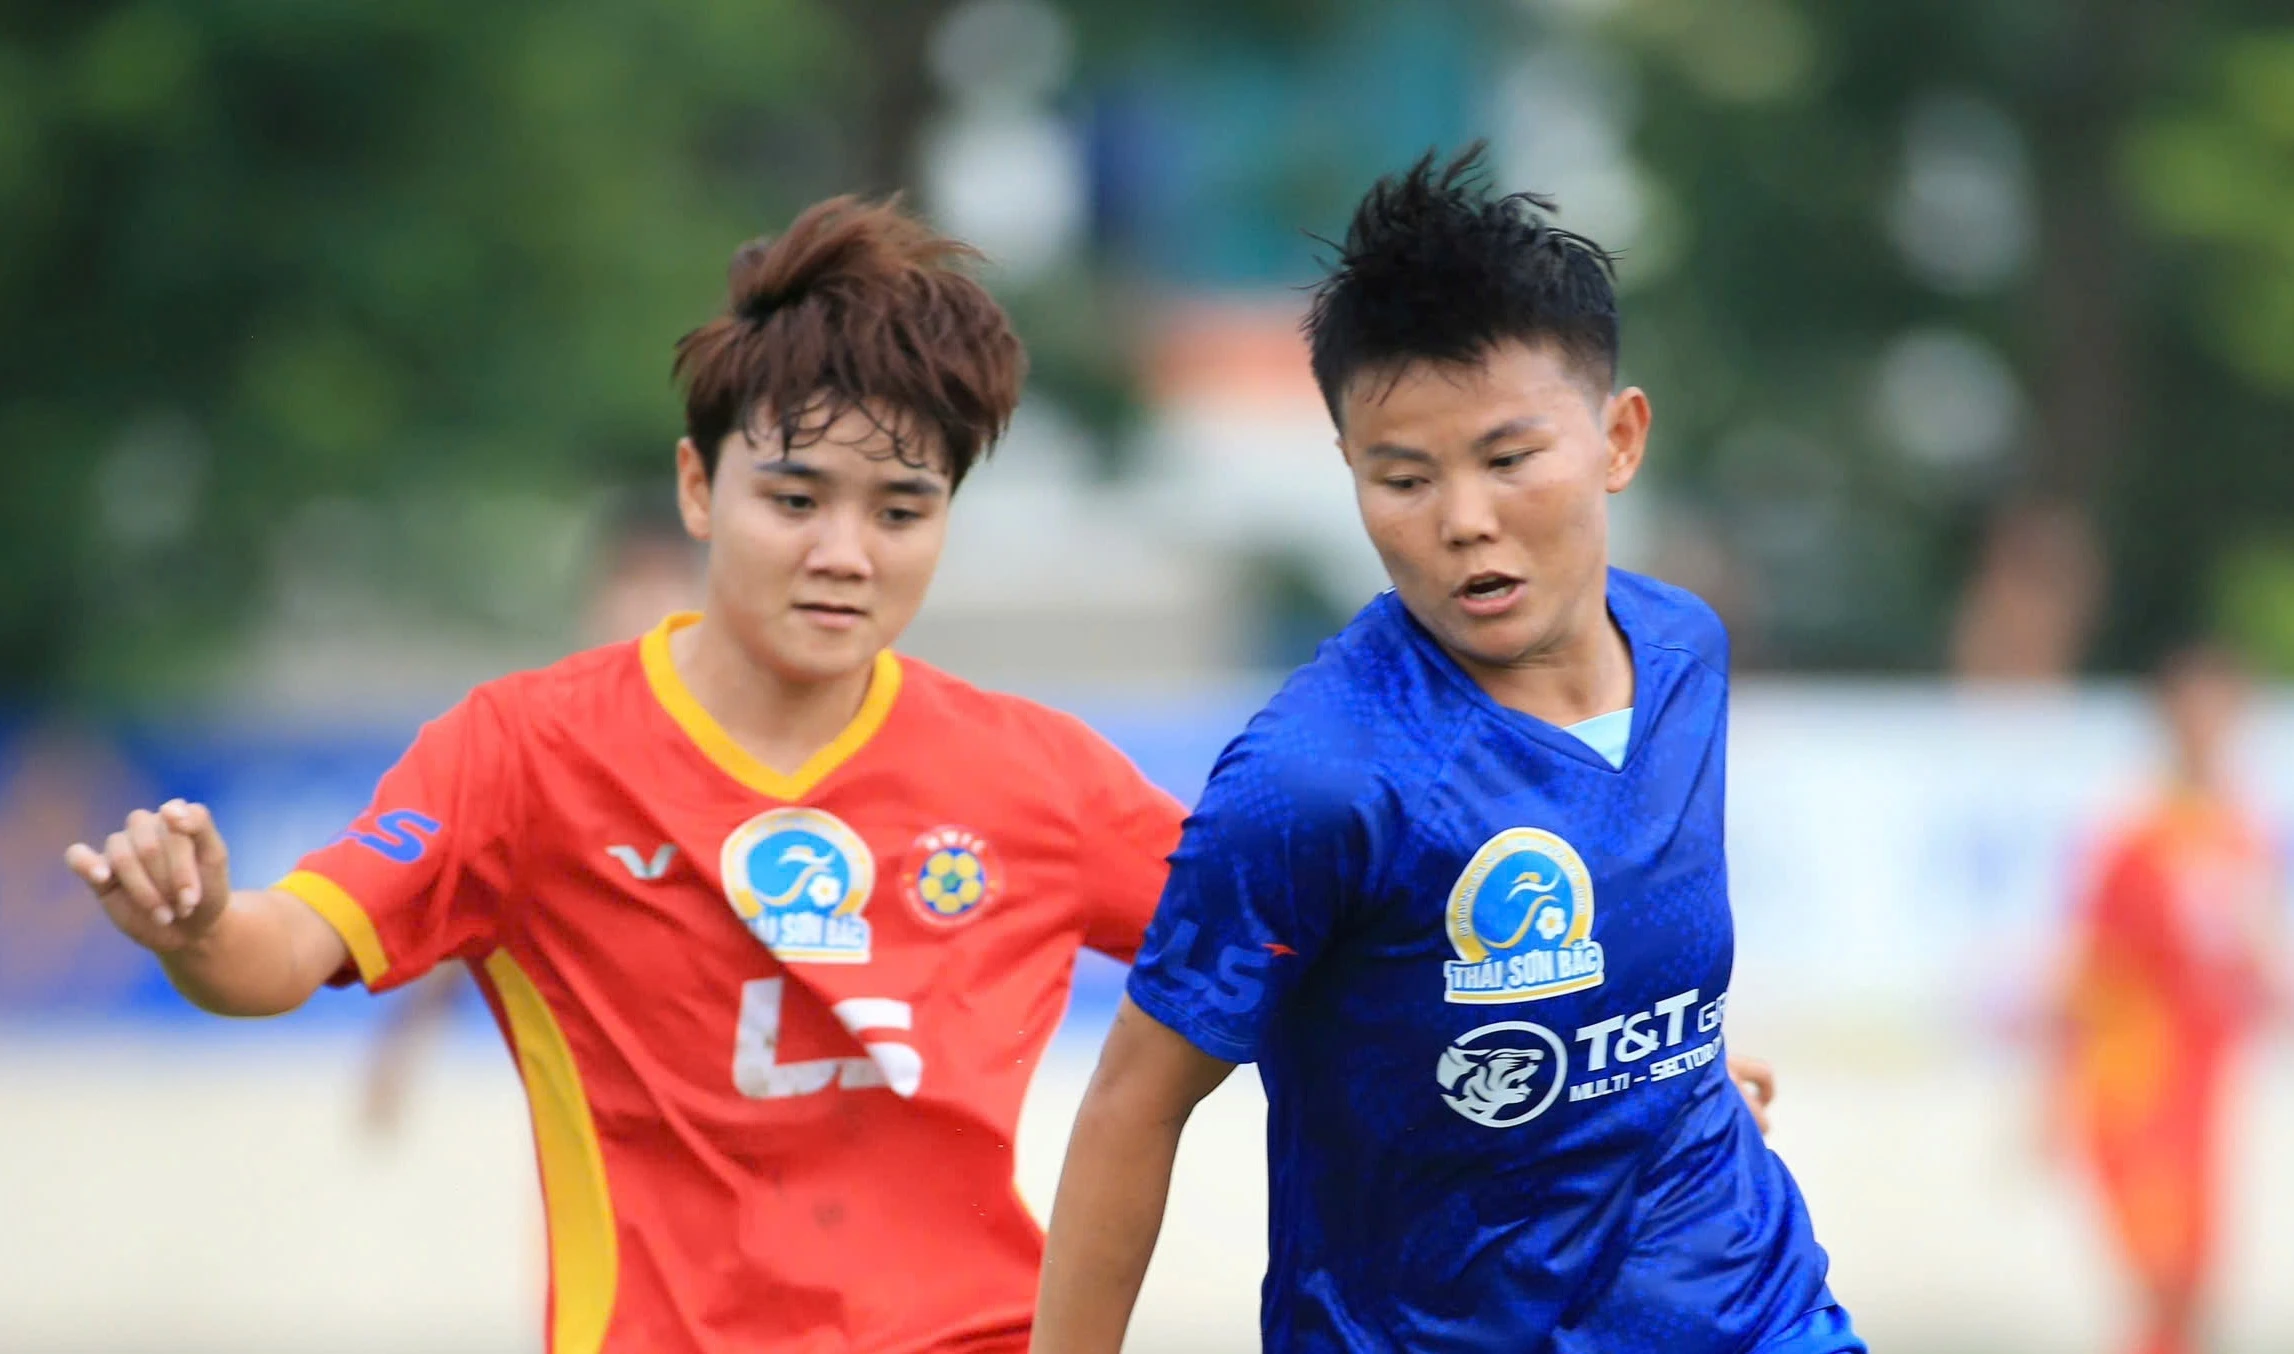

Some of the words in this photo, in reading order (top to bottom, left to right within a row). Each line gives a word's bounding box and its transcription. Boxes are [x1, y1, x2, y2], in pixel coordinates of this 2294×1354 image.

[1164, 919, 1271, 1014] LS
[1451, 957, 1504, 988] THÁI
[1508, 949, 1556, 987] SƠN
[1574, 988, 1699, 1072] T&T
[1569, 1072, 1631, 1103] MULTI
